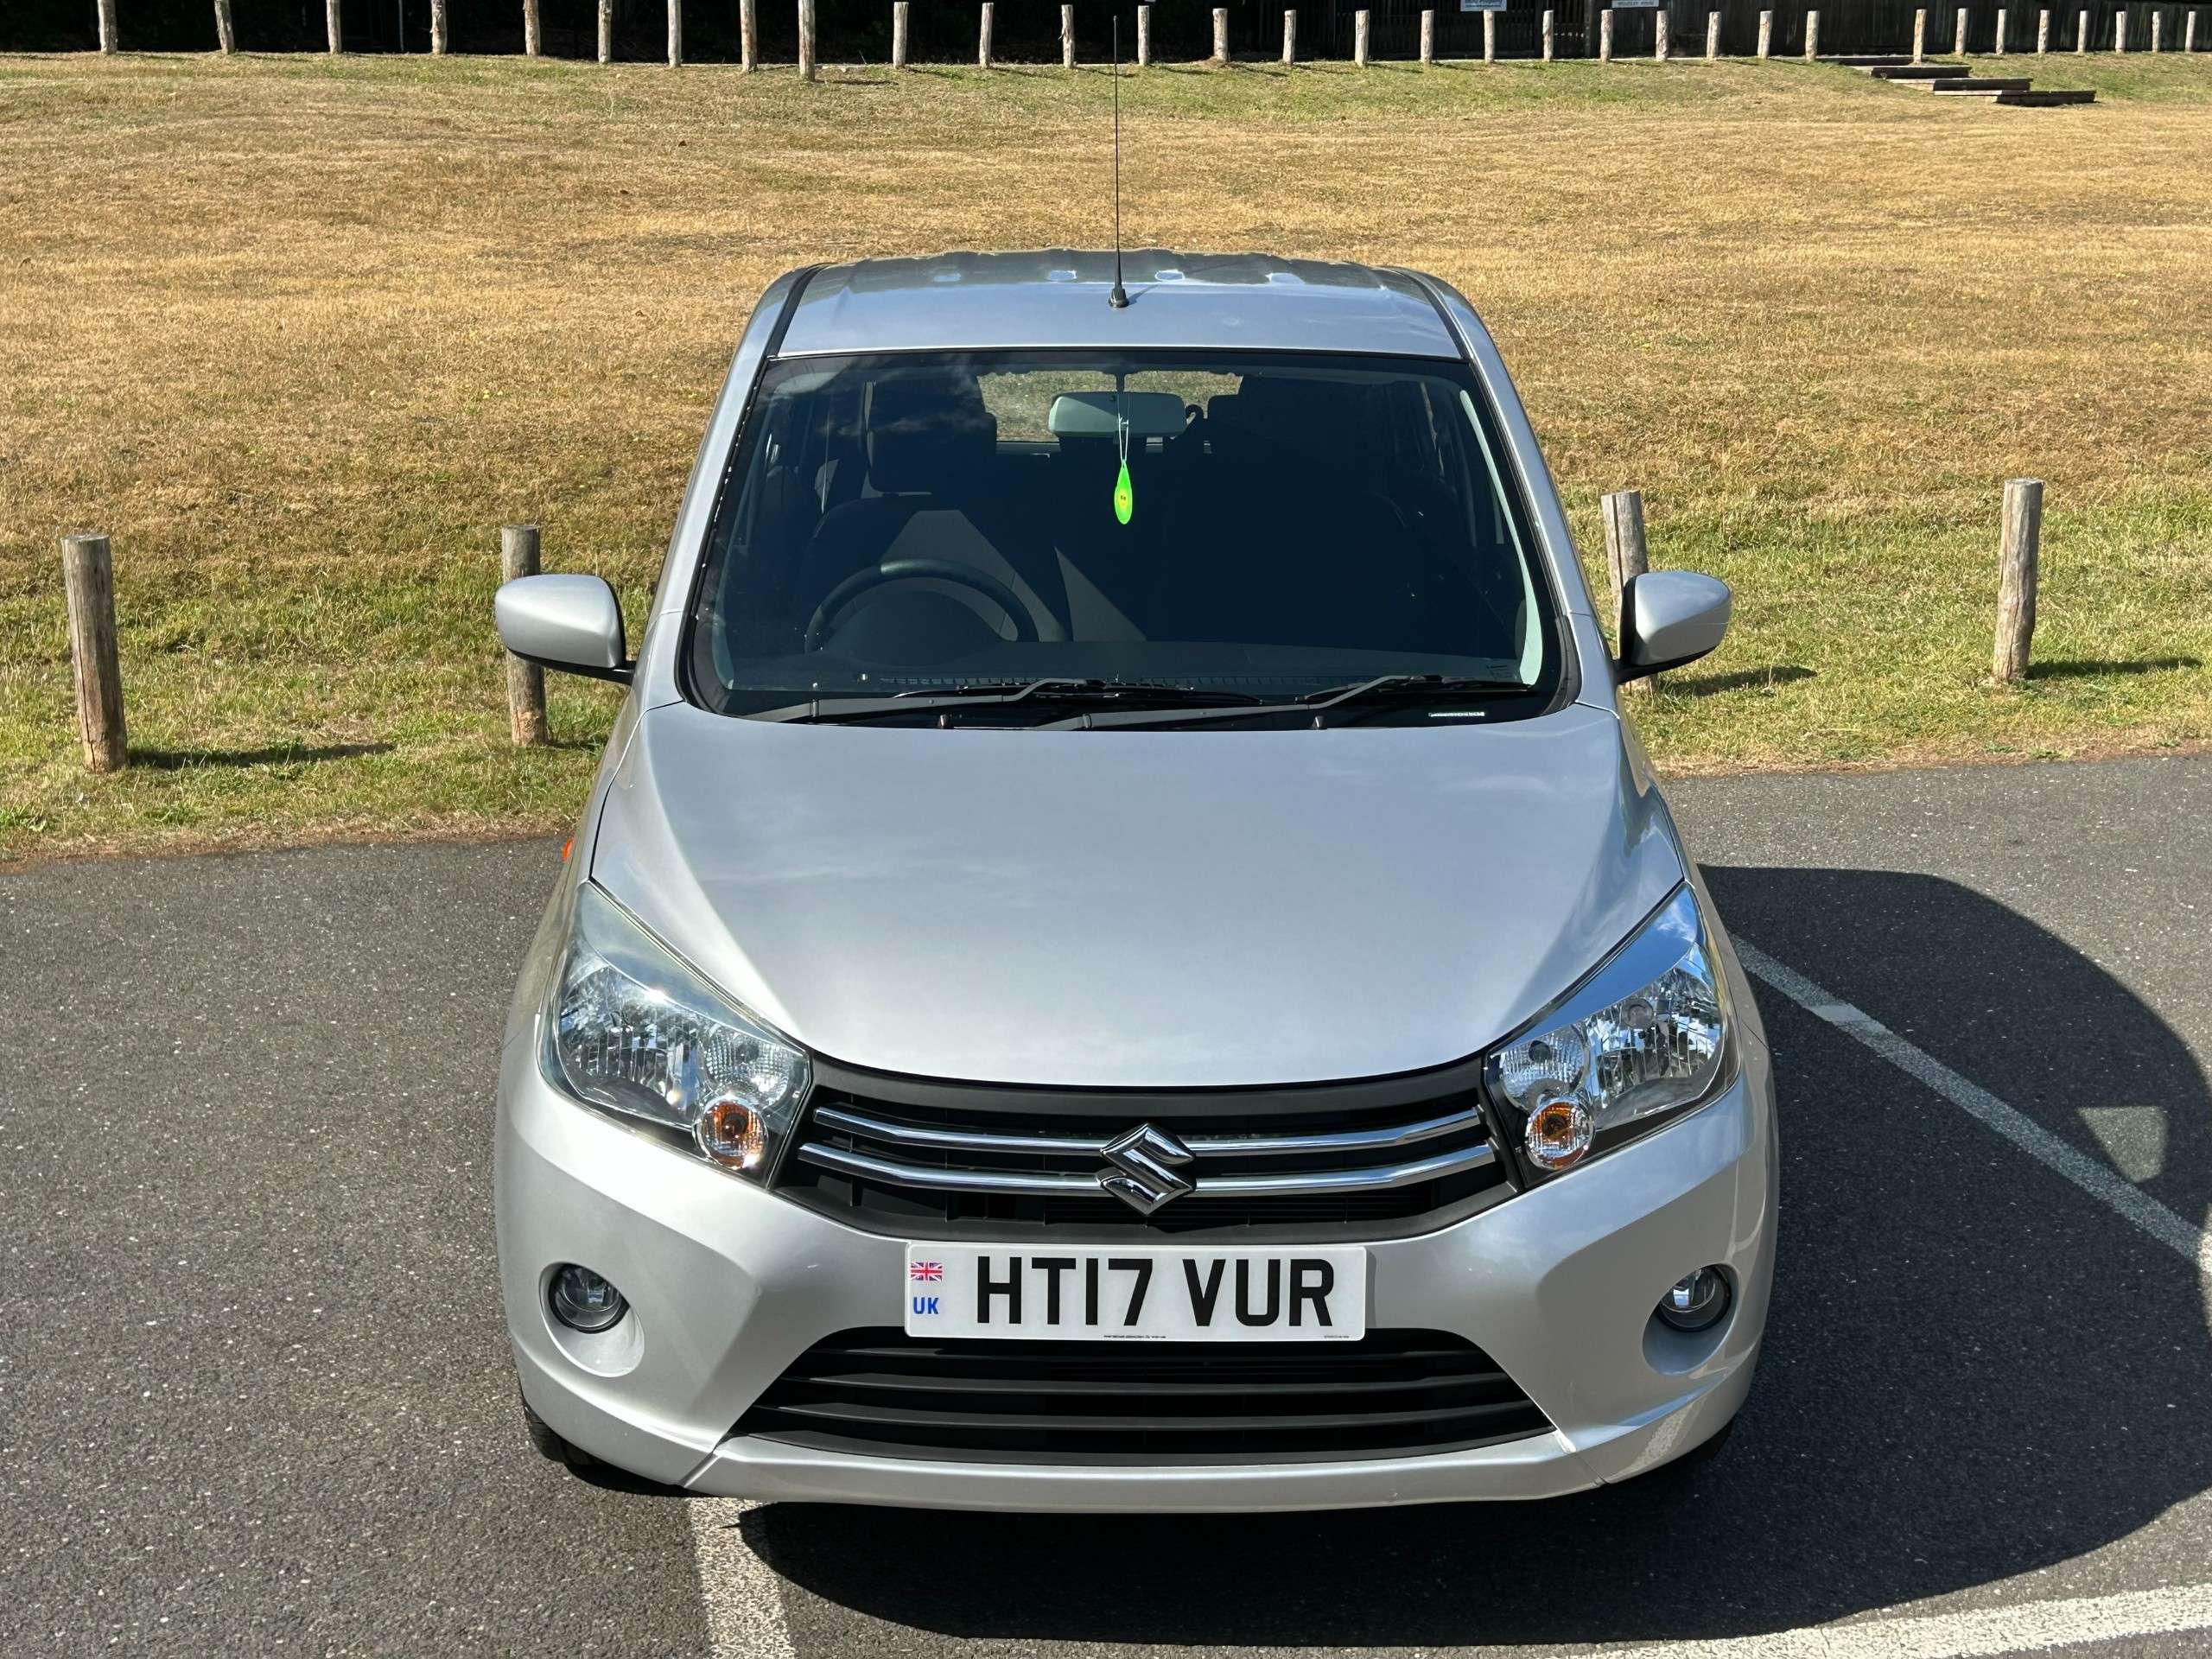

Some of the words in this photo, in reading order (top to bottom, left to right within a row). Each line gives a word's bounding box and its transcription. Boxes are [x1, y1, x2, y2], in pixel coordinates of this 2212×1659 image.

[913, 1296, 939, 1315] UK
[976, 1255, 1154, 1326] HT17
[1182, 1258, 1335, 1327] VUR
